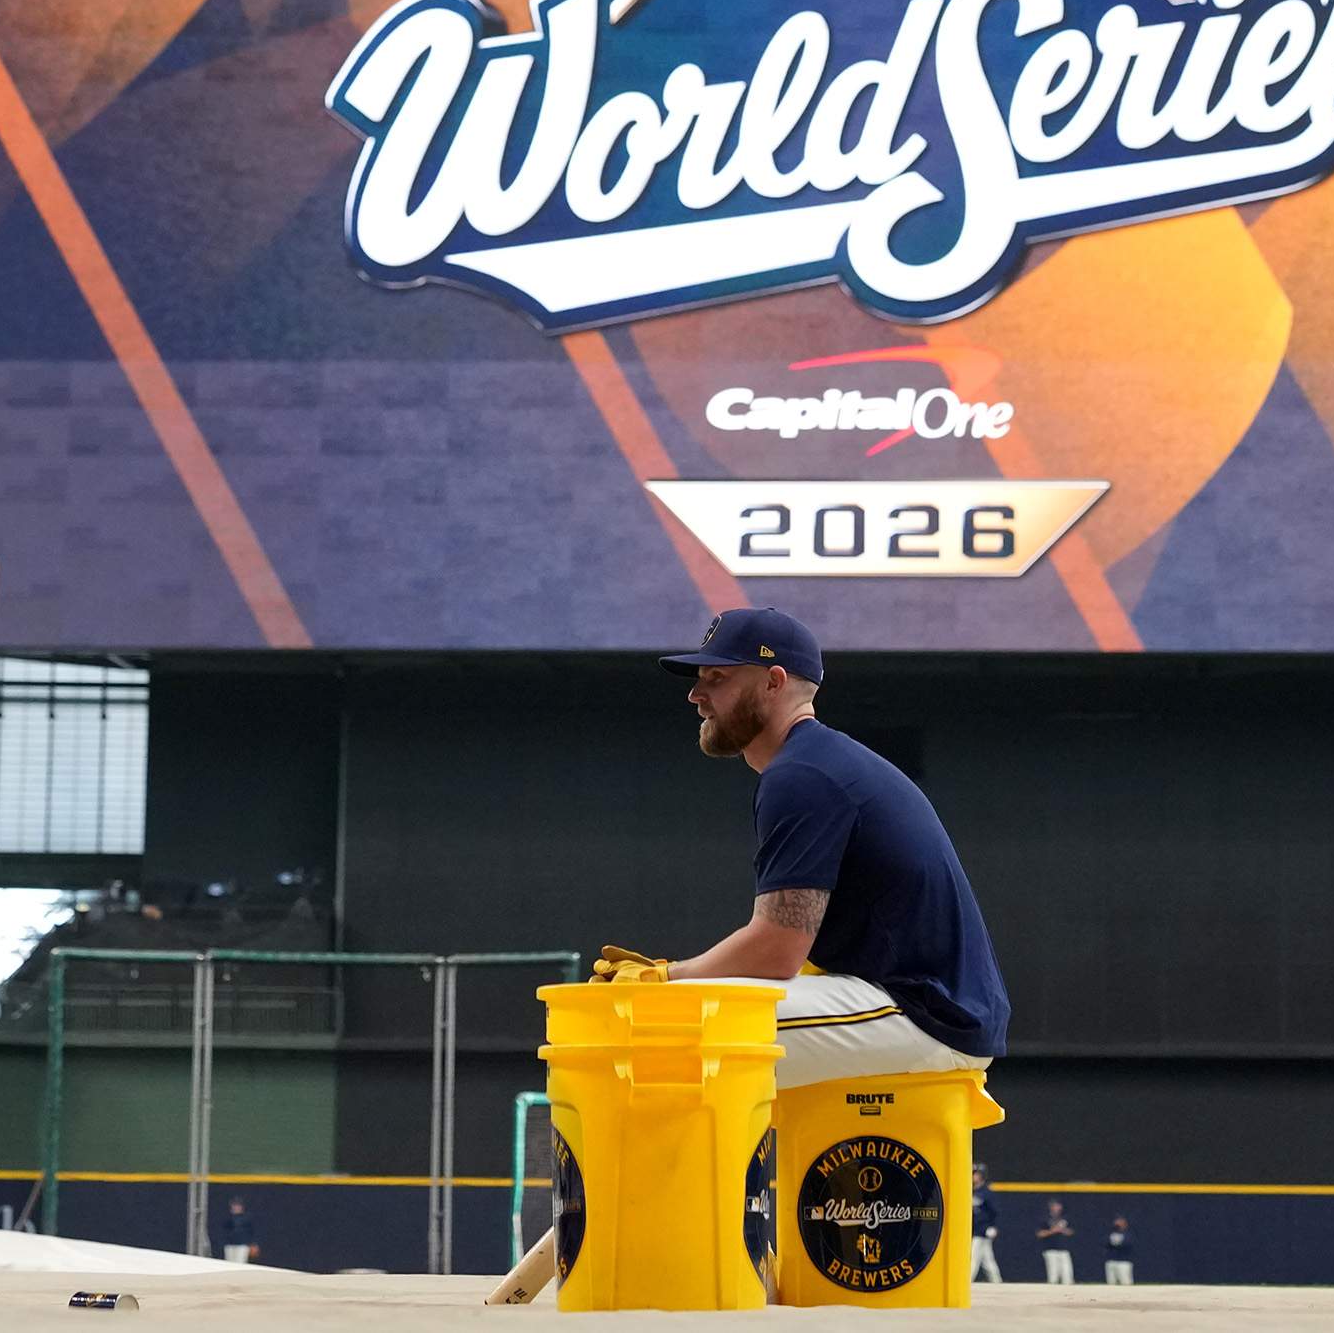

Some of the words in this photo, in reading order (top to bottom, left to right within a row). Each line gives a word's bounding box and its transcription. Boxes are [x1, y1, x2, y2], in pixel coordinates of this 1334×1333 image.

[739, 504, 1015, 559] 2026
[846, 1093, 894, 1104] BRUTE
[817, 1141, 925, 1178] MILWAUKEE
[825, 1198, 874, 1222] World
[865, 1200, 911, 1229] Series
[828, 1258, 914, 1287] BREWERS
